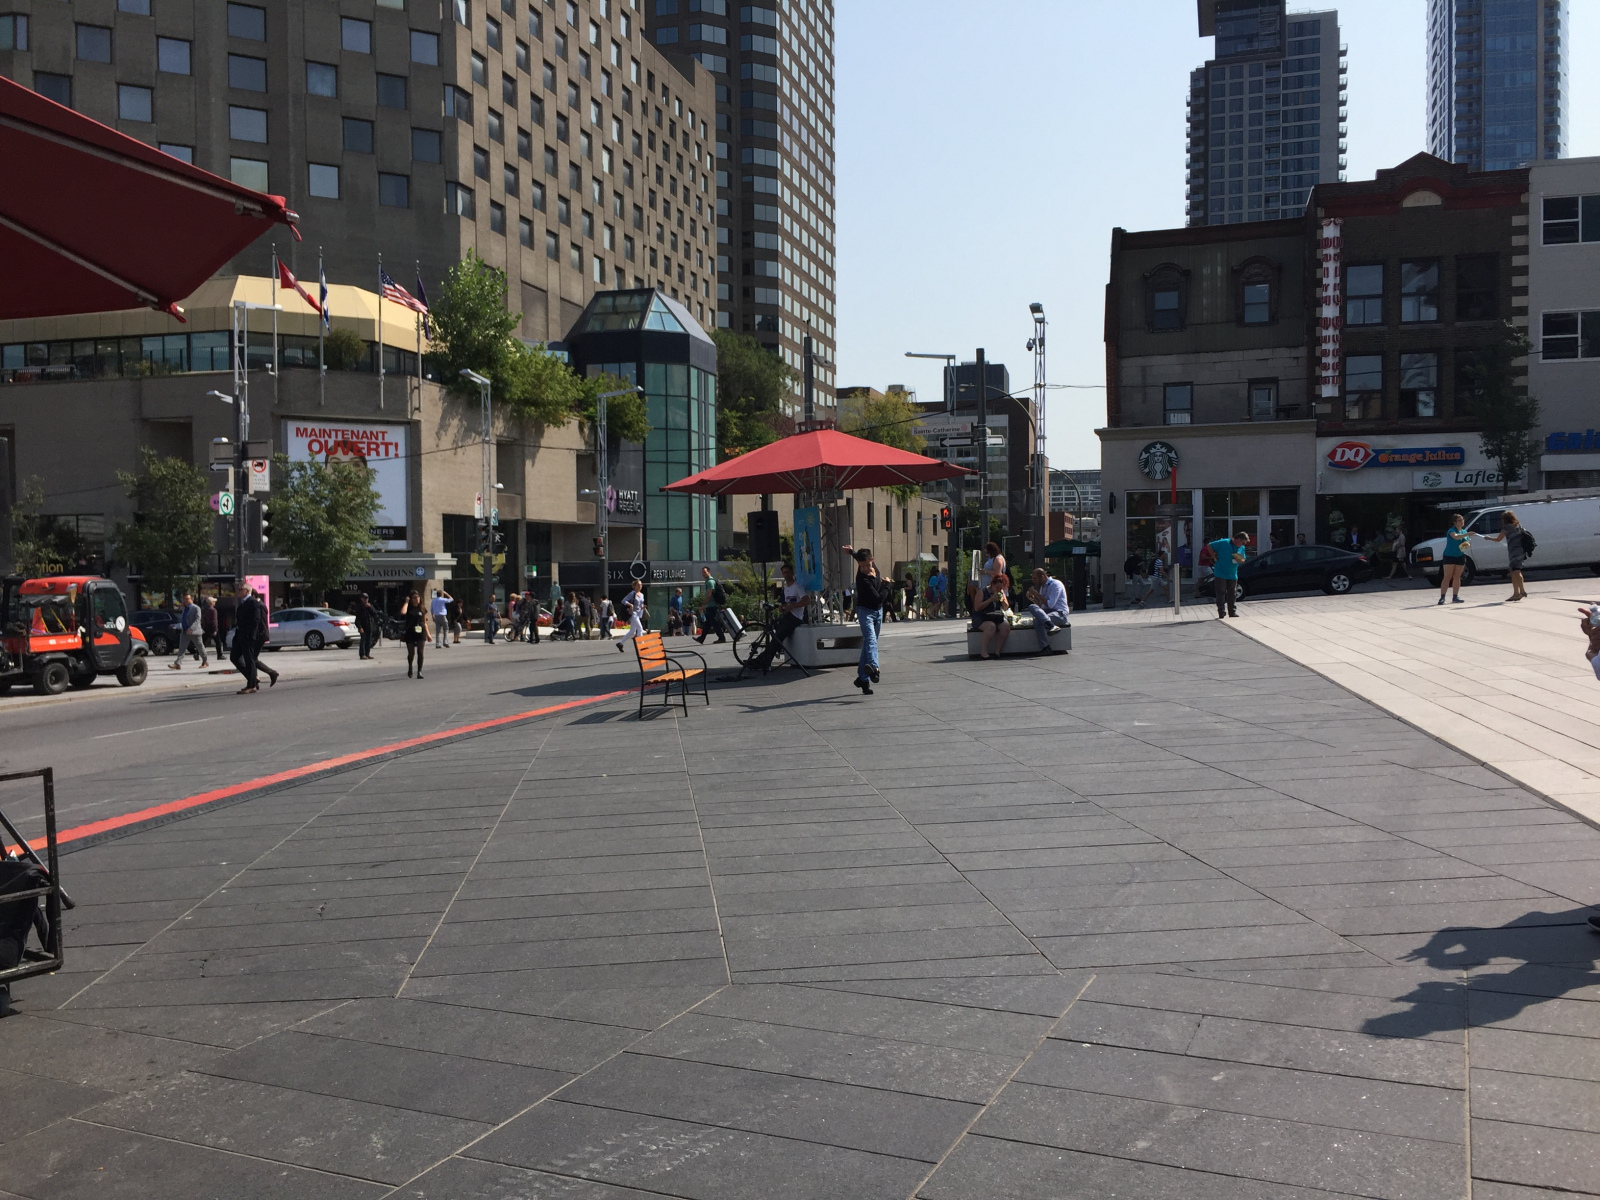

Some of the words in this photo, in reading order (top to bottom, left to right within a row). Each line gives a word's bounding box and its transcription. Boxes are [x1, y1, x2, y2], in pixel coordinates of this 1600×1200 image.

[295, 427, 388, 440] MAINTENANT
[913, 426, 960, 434] Sainte-Catherine
[307, 439, 399, 458] OUVERT!
[1334, 447, 1365, 462] DQ
[1424, 450, 1461, 462] Julius
[619, 490, 638, 500] HYATT
